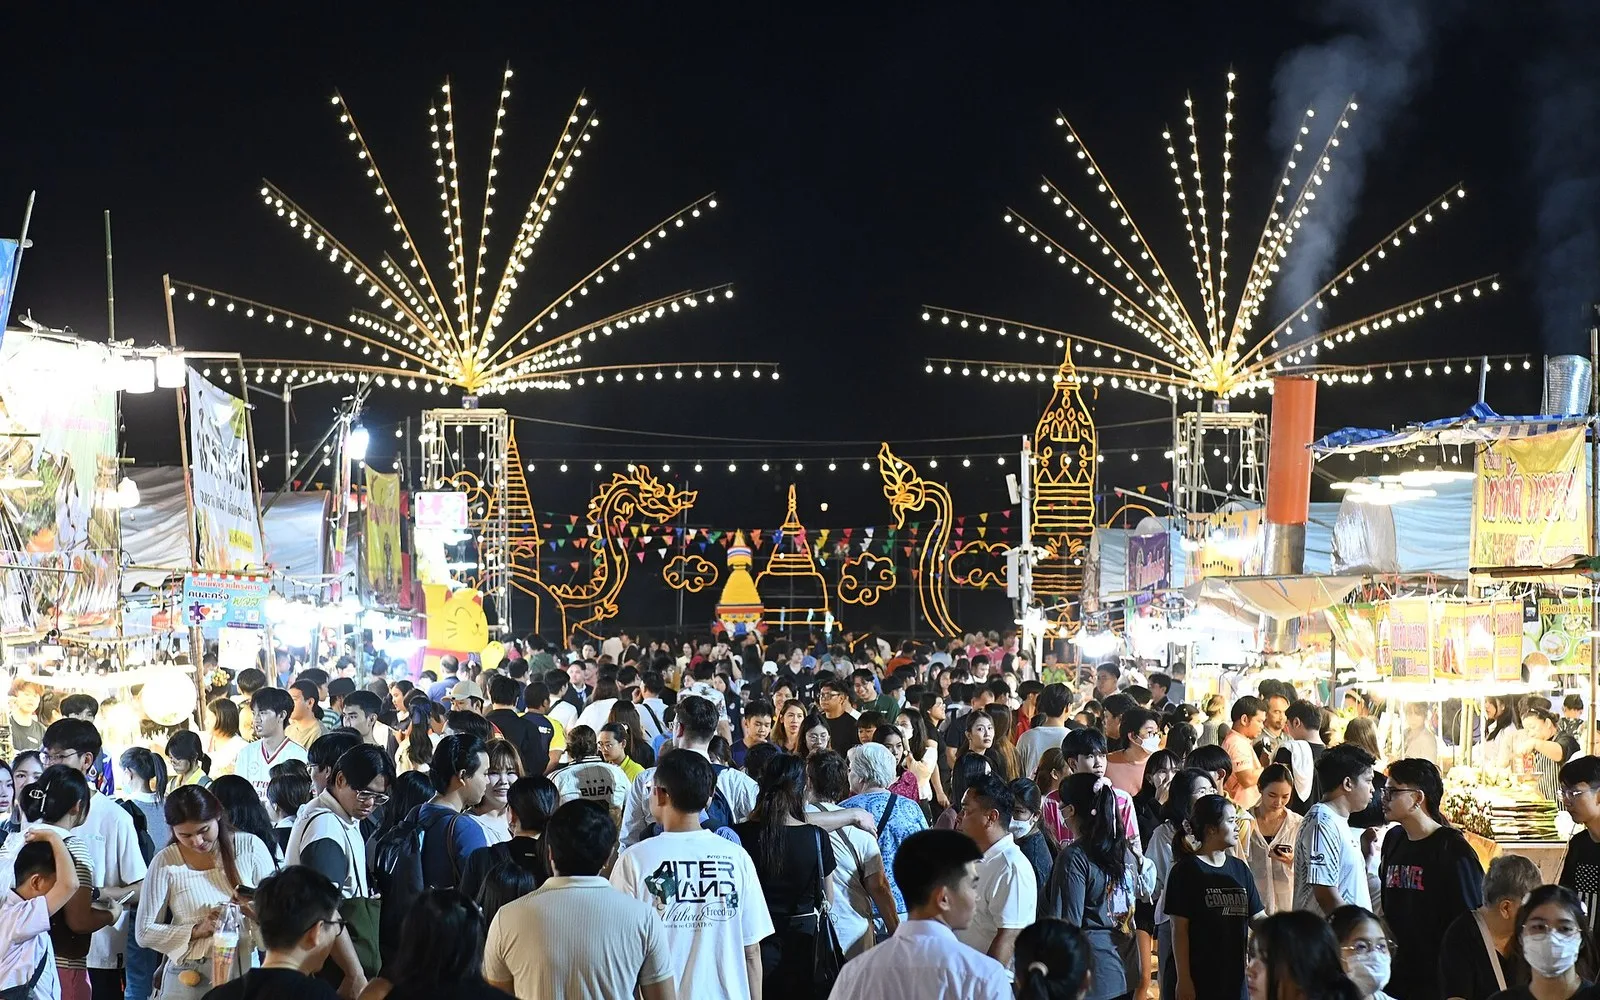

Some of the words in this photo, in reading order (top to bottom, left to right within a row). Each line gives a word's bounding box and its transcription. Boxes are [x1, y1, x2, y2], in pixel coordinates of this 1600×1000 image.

[188, 589, 230, 600] คนละครึ่ง
[1386, 864, 1425, 891] MARVEL
[661, 901, 705, 921] Without
